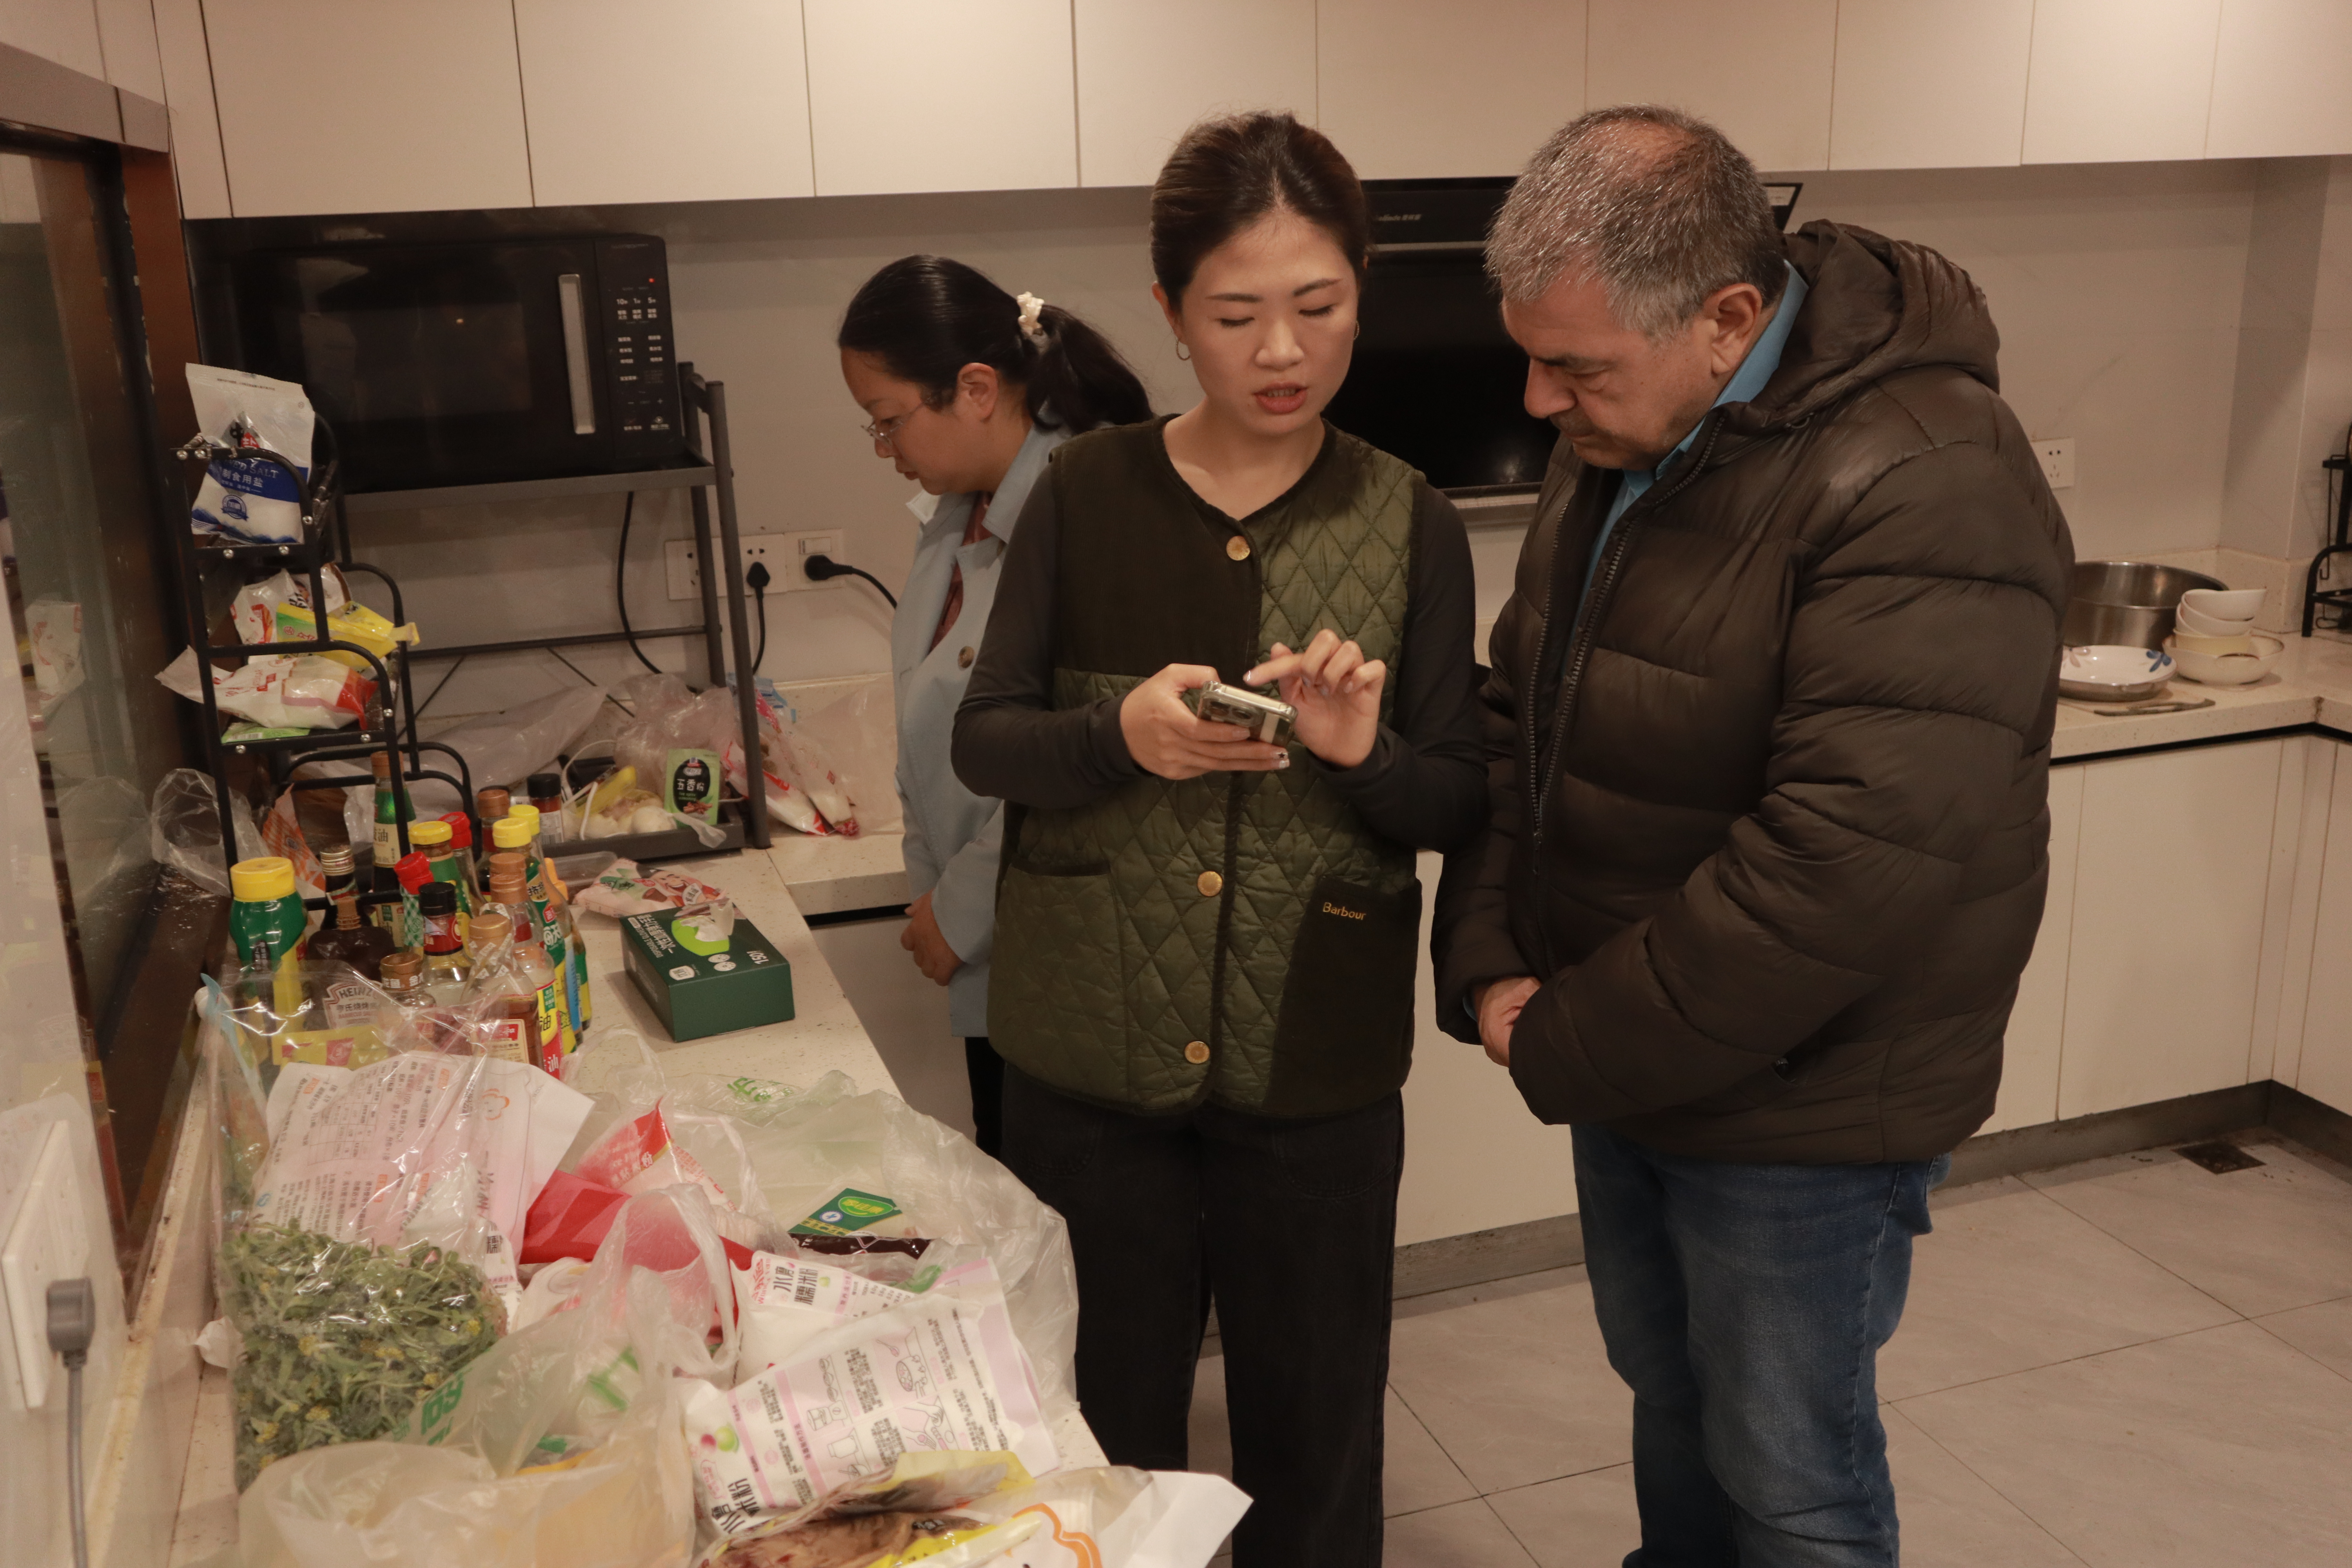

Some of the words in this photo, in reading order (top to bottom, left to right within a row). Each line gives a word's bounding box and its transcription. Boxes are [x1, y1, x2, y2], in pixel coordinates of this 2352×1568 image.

[250, 465, 279, 478] SALT
[677, 779, 704, 791] 五香粉
[1323, 902, 1367, 920] Barbour
[644, 938, 664, 958] DISPOSABLE
[338, 987, 373, 998] HEINZ
[773, 1266, 794, 1293] 水磨
[794, 1268, 818, 1305] 糯米粉
